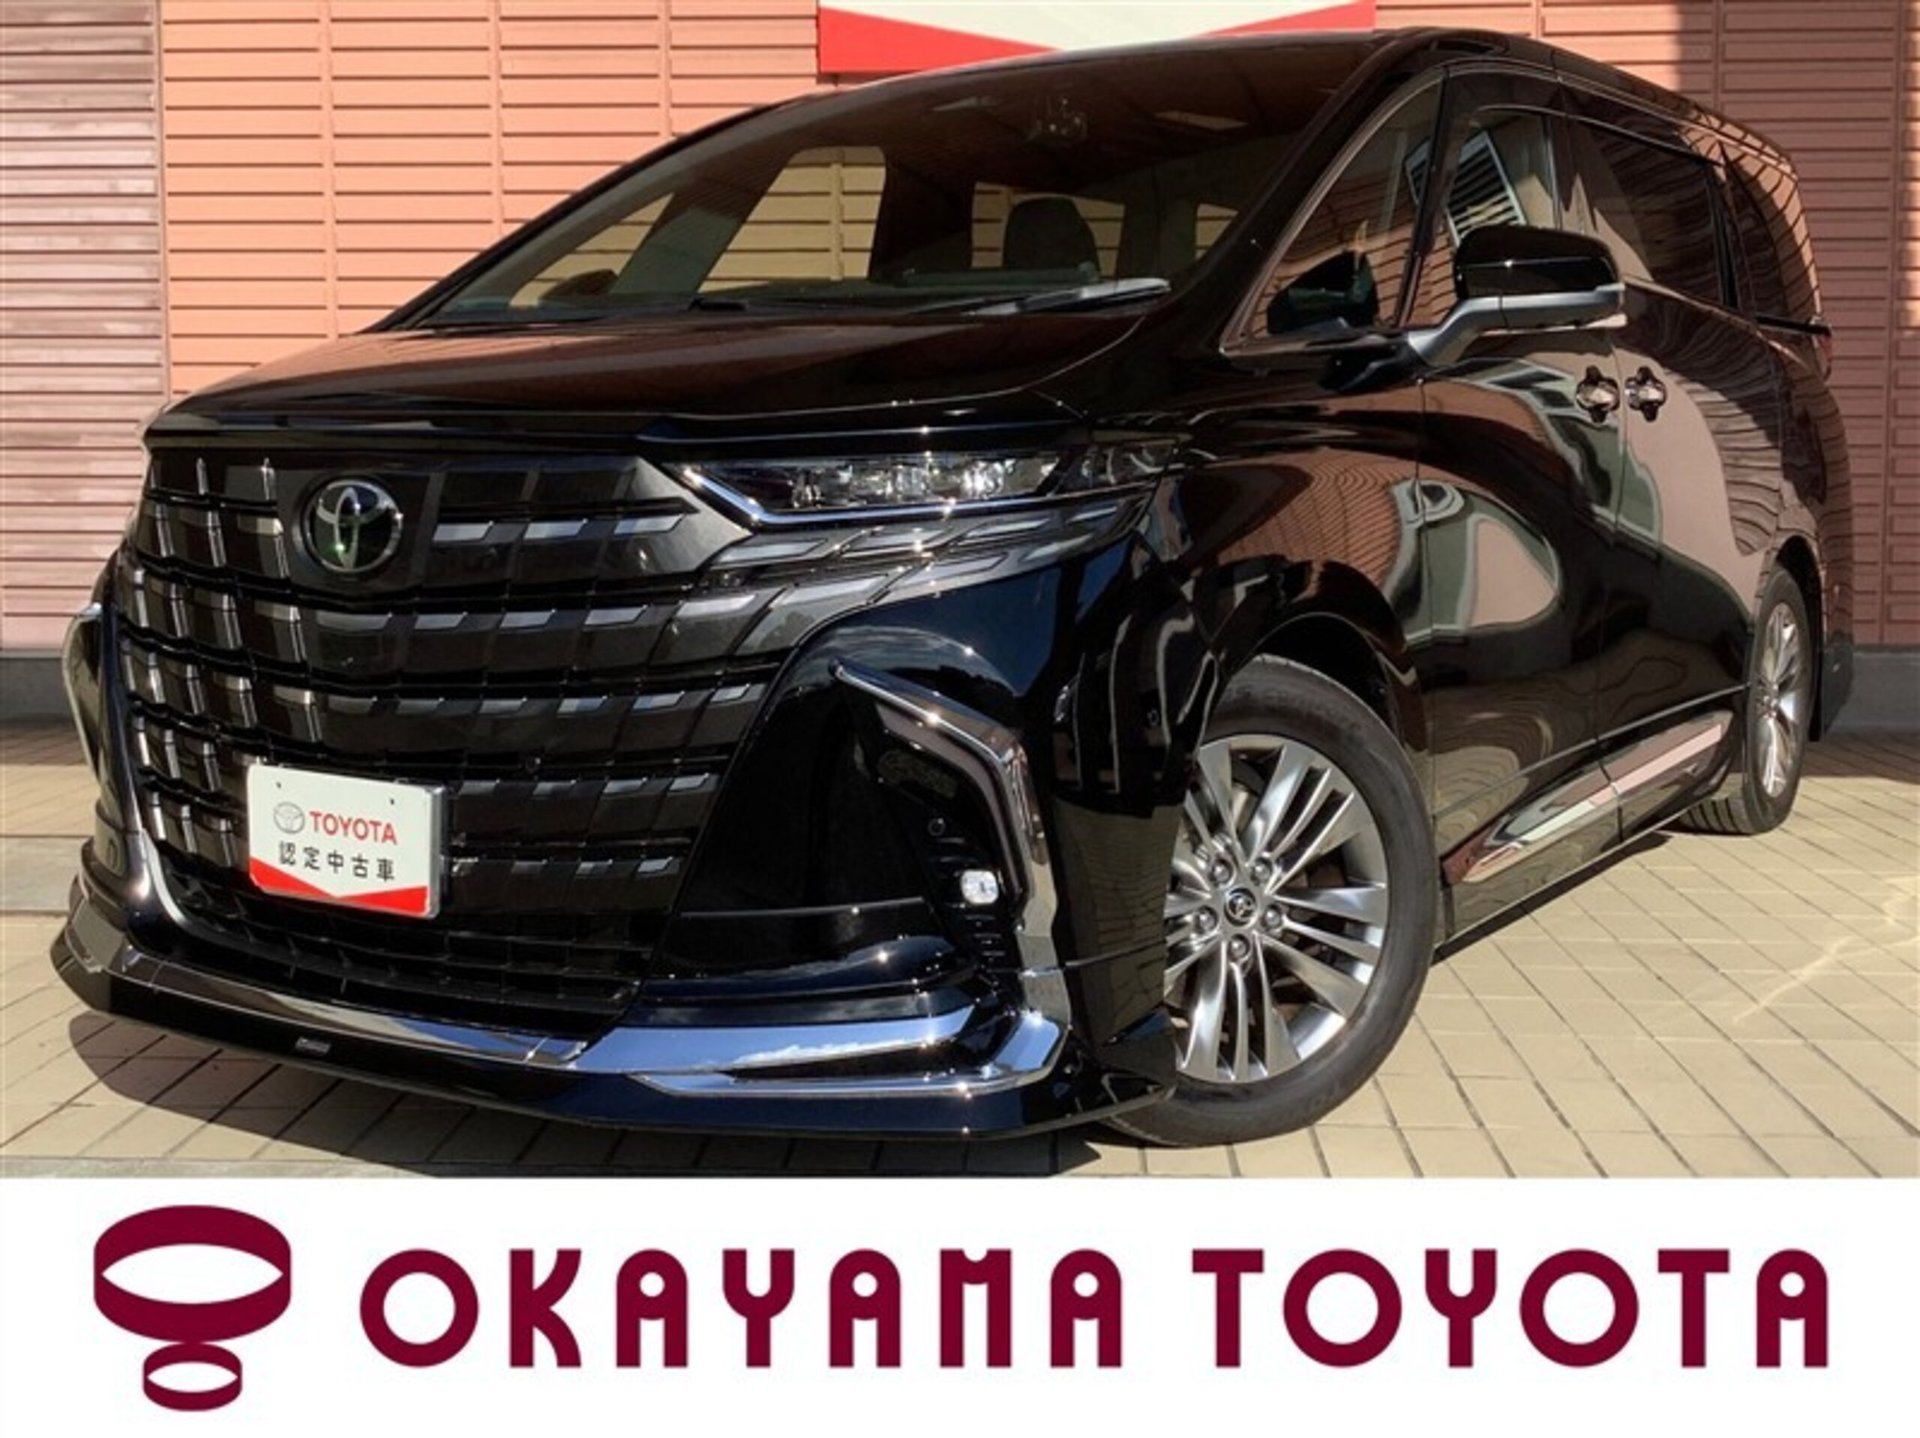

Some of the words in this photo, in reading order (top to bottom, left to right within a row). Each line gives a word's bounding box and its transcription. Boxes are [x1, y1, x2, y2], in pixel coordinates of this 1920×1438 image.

[309, 811, 397, 845] TOYOTA
[279, 841, 395, 882] 認定中古車
